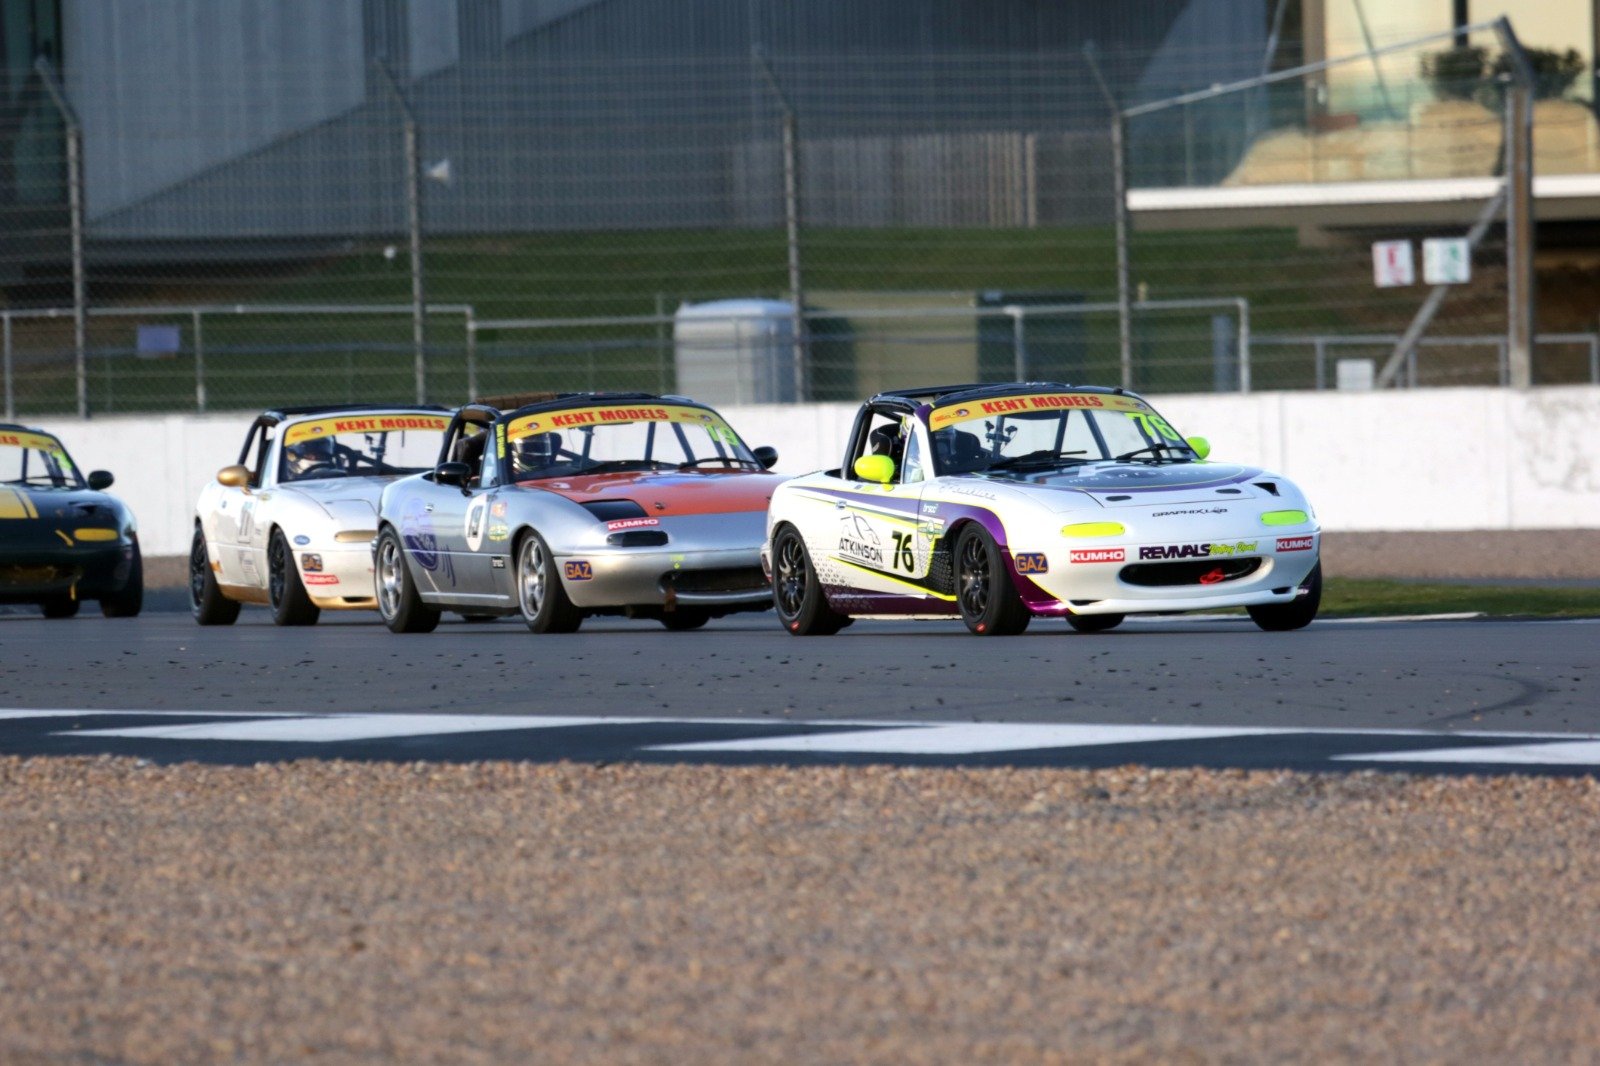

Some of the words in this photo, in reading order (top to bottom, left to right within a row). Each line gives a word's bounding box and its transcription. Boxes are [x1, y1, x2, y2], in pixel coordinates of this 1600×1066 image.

[981, 398, 1028, 414] KENT
[1030, 395, 1104, 409] MODELS
[334, 419, 376, 432] KENT
[380, 418, 446, 430] MODELS
[551, 411, 596, 427] KENT
[599, 408, 669, 421] MODELS
[1124, 412, 1181, 441] 76
[704, 424, 739, 447] 19
[608, 519, 659, 531] KUMHO
[838, 538, 884, 564] ATKINSON
[891, 530, 915, 573] 76
[1139, 543, 1211, 560] REVIVALS
[1276, 538, 1313, 552] KUMHO
[1016, 555, 1047, 572] GAZ
[1070, 550, 1124, 562] KUMHO
[565, 562, 592, 579] GAZ
